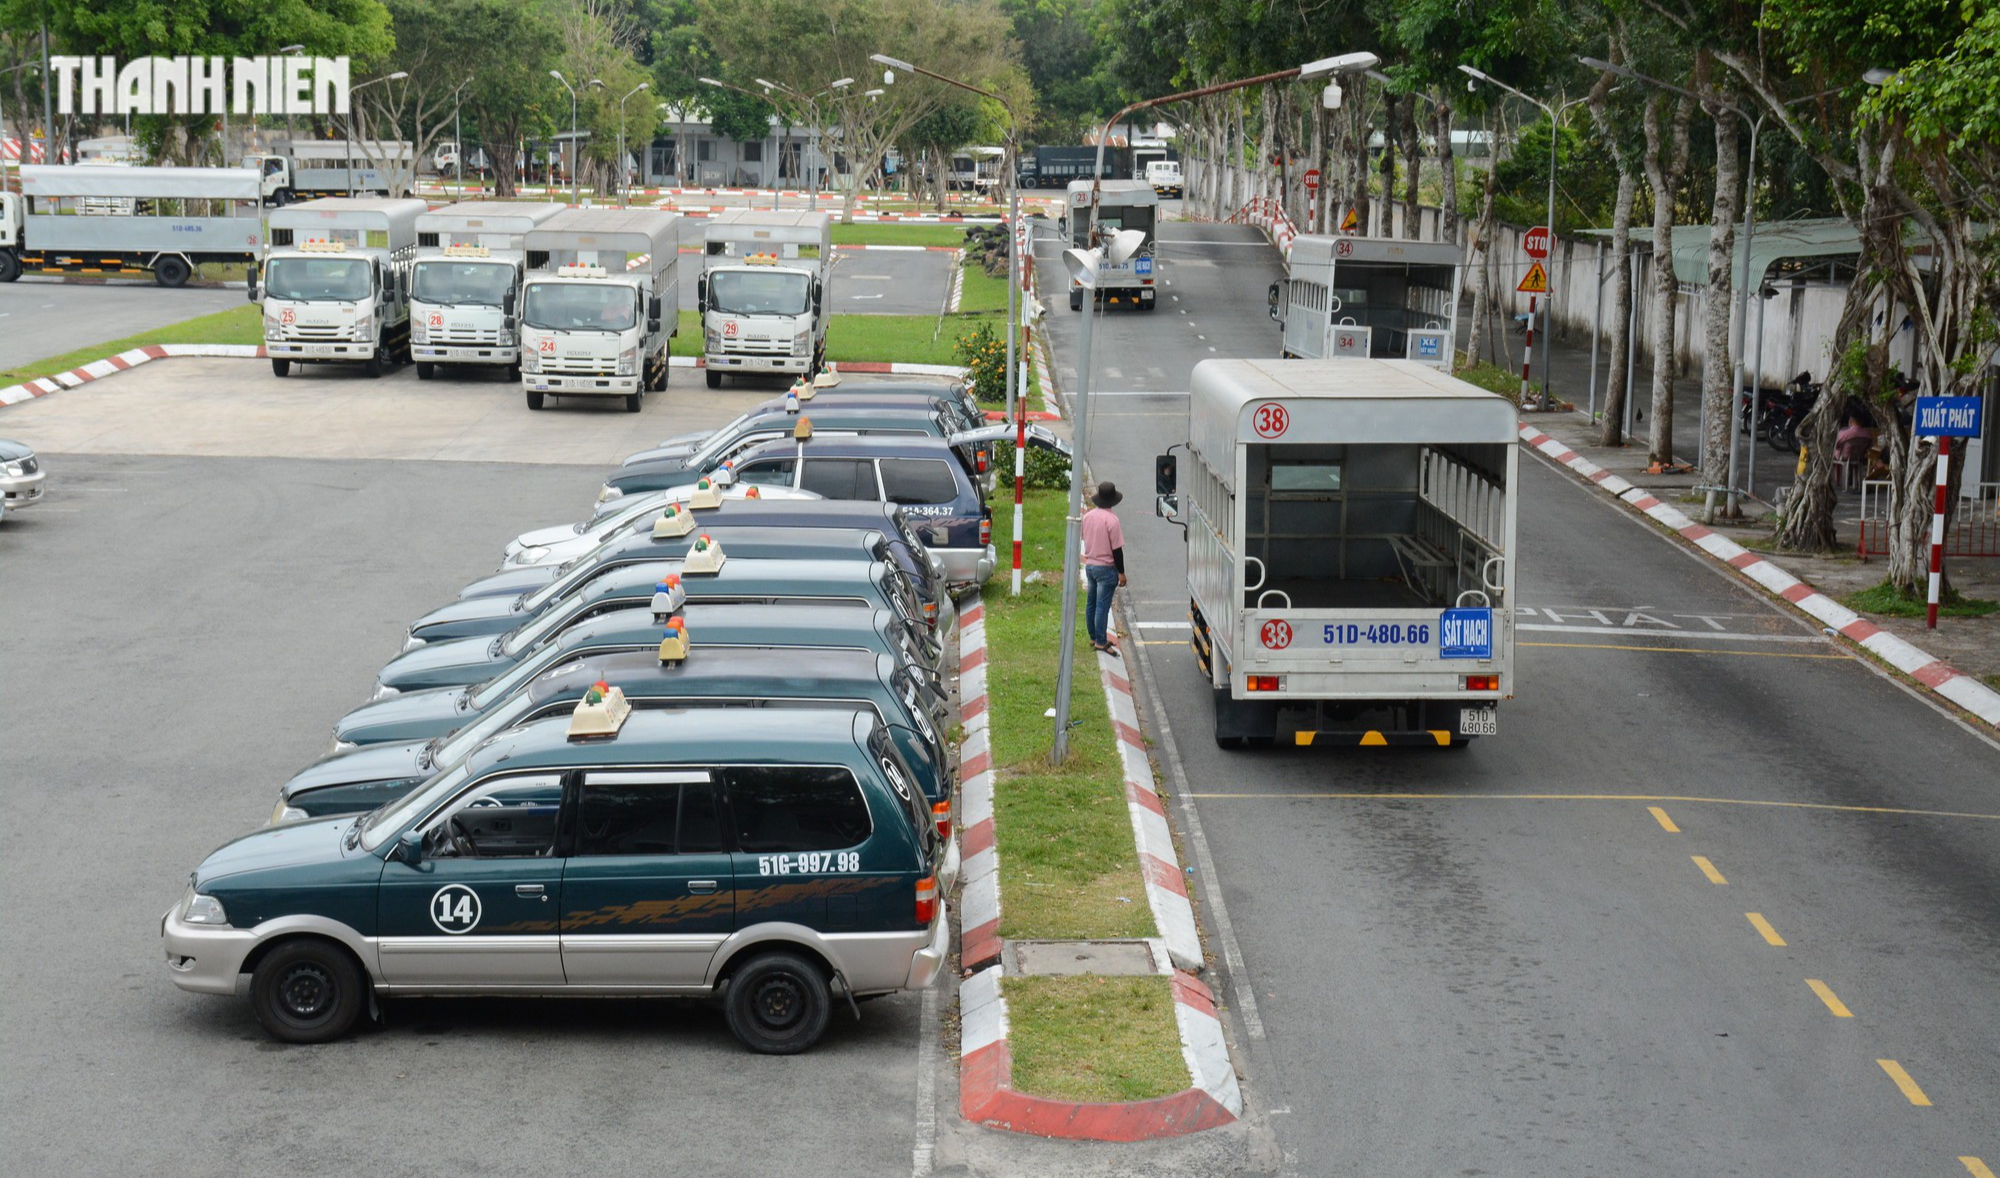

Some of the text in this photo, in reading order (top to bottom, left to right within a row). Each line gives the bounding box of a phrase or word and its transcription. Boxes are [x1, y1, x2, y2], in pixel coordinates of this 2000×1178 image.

[1077, 193, 1087, 202] 23
[1338, 243, 1351, 254] 34
[1527, 236, 1548, 250] STO
[283, 311, 294, 323] 25
[431, 316, 442, 325] 28
[725, 324, 736, 334] 29
[541, 342, 554, 351] 24
[1340, 338, 1353, 347] 34
[1259, 408, 1284, 432] 38
[1921, 401, 1975, 428] XUẤT PHÁT
[1265, 622, 1289, 648] 38
[1324, 624, 1429, 644] 51D-480.66
[1444, 614, 1487, 652] SÁT HẠCH
[1469, 710, 1488, 722] 51D
[1461, 722, 1496, 734] 480.66
[759, 852, 860, 876] 51G-997.98
[438, 893, 474, 923] 14
